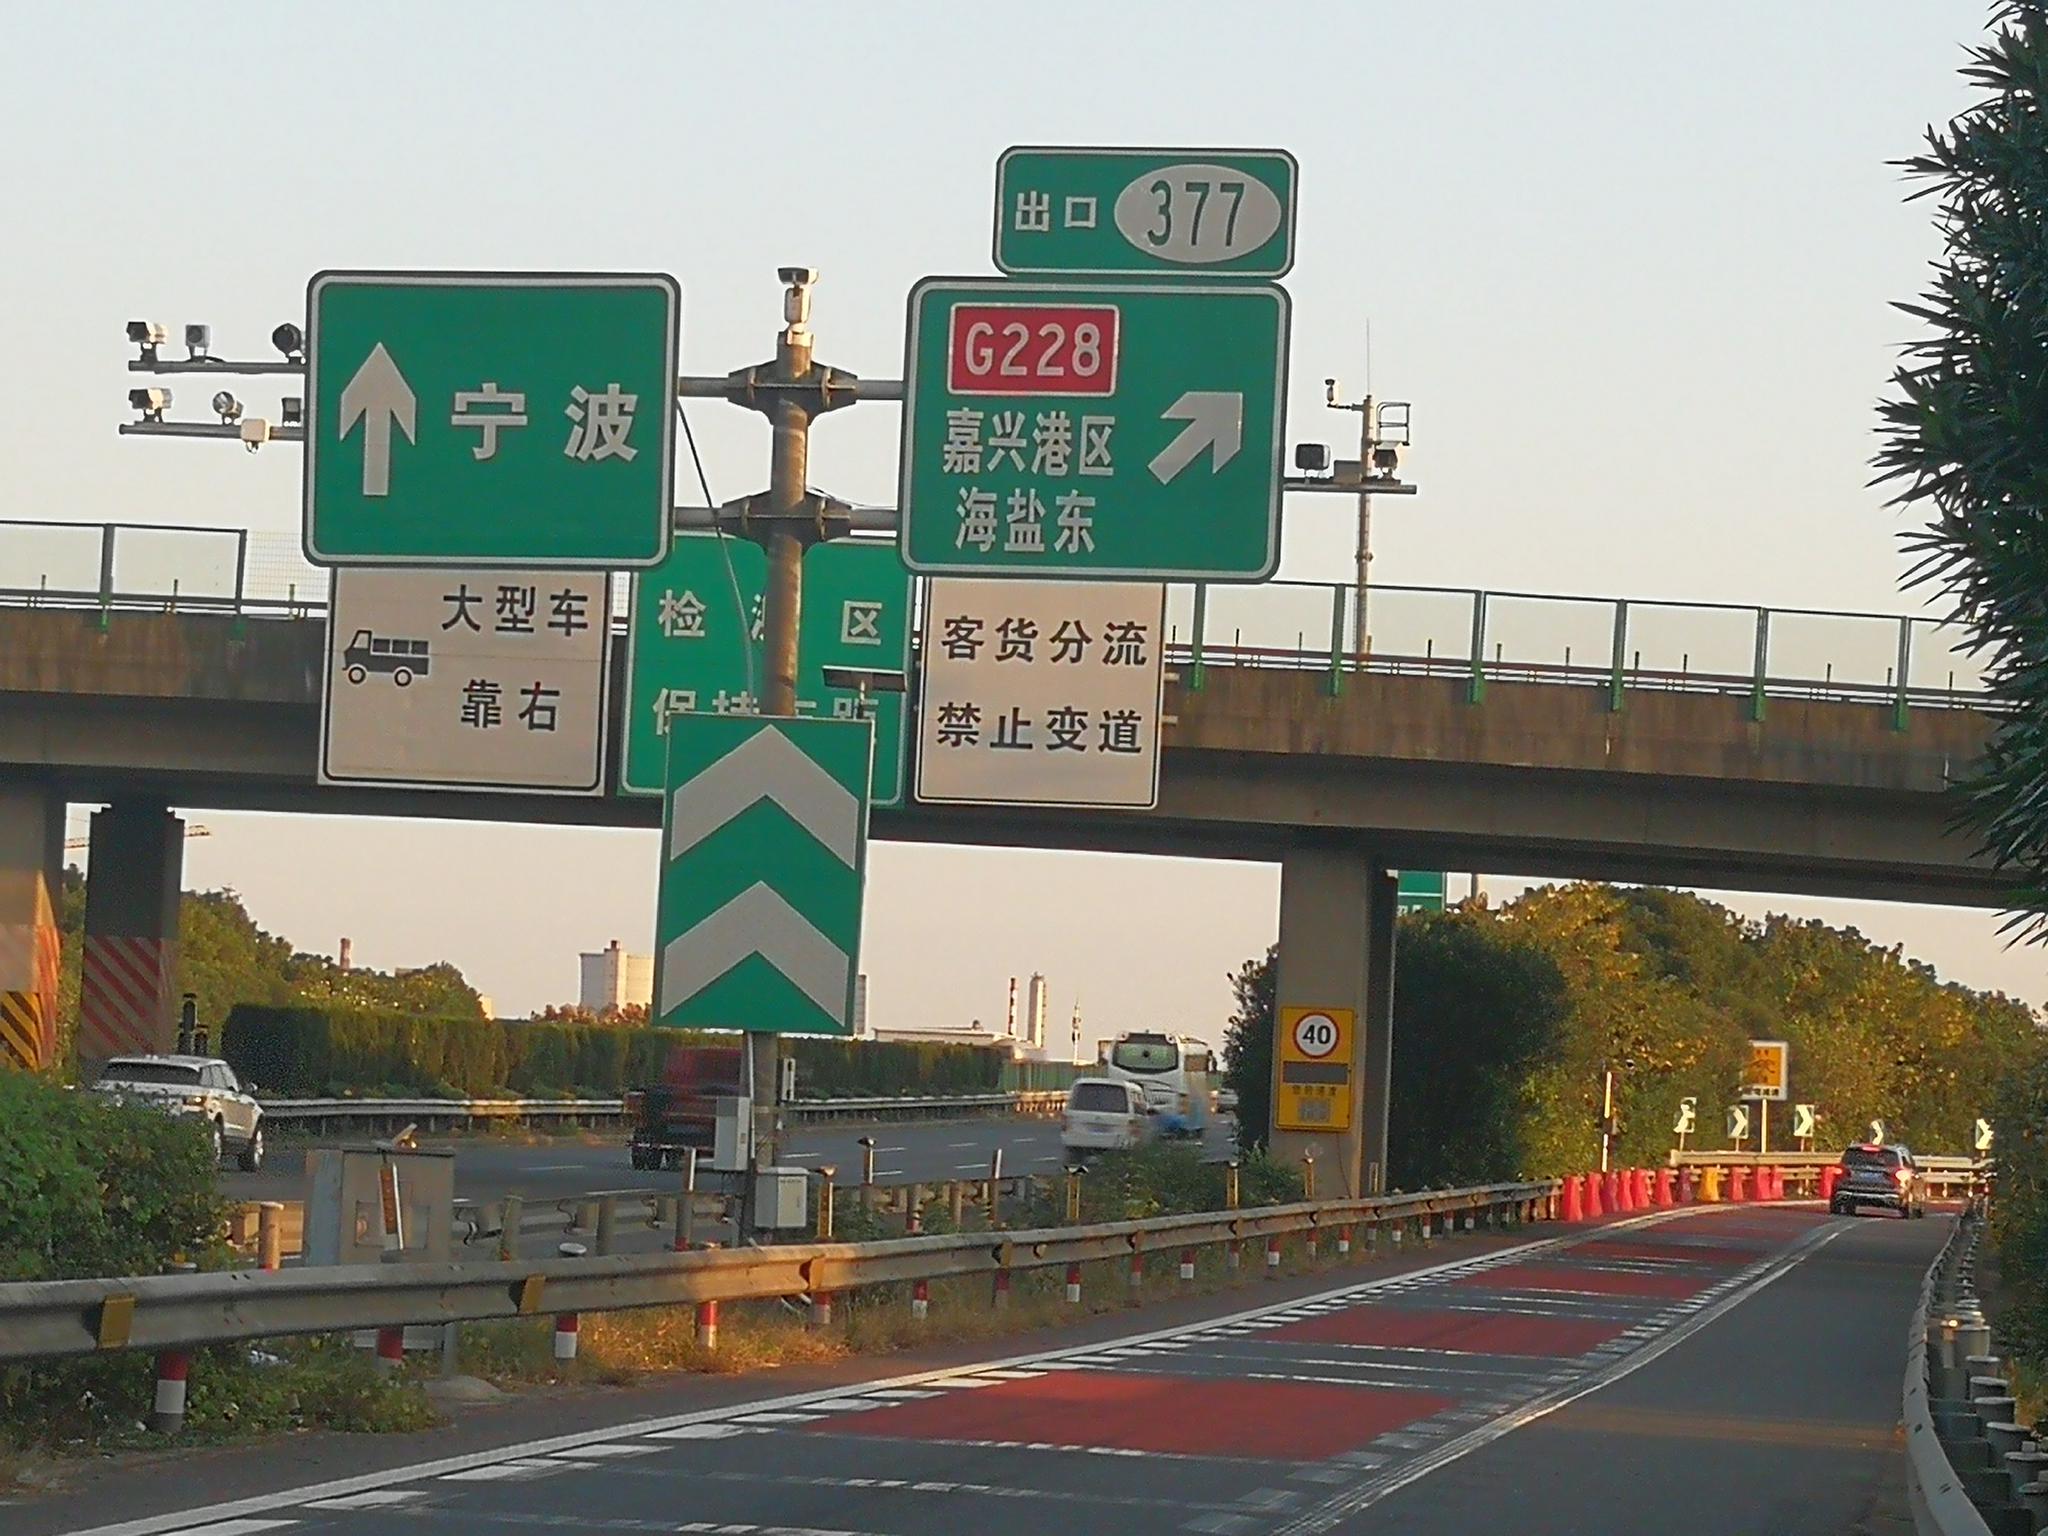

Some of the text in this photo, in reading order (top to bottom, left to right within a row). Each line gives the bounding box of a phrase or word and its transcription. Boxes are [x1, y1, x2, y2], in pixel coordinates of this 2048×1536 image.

[1014, 179, 1246, 248] 出口 377
[964, 321, 1101, 378] G228
[450, 382, 639, 462] 宁波
[943, 406, 1116, 477] 嘉兴港区
[954, 485, 1096, 553] 海盐东
[441, 583, 589, 637] 大型车
[658, 589, 883, 645] 检区
[940, 615, 1149, 667] 客货分流
[460, 678, 561, 732] 靠右
[936, 701, 1143, 754] 禁止变道
[1302, 1023, 1332, 1045] 40
